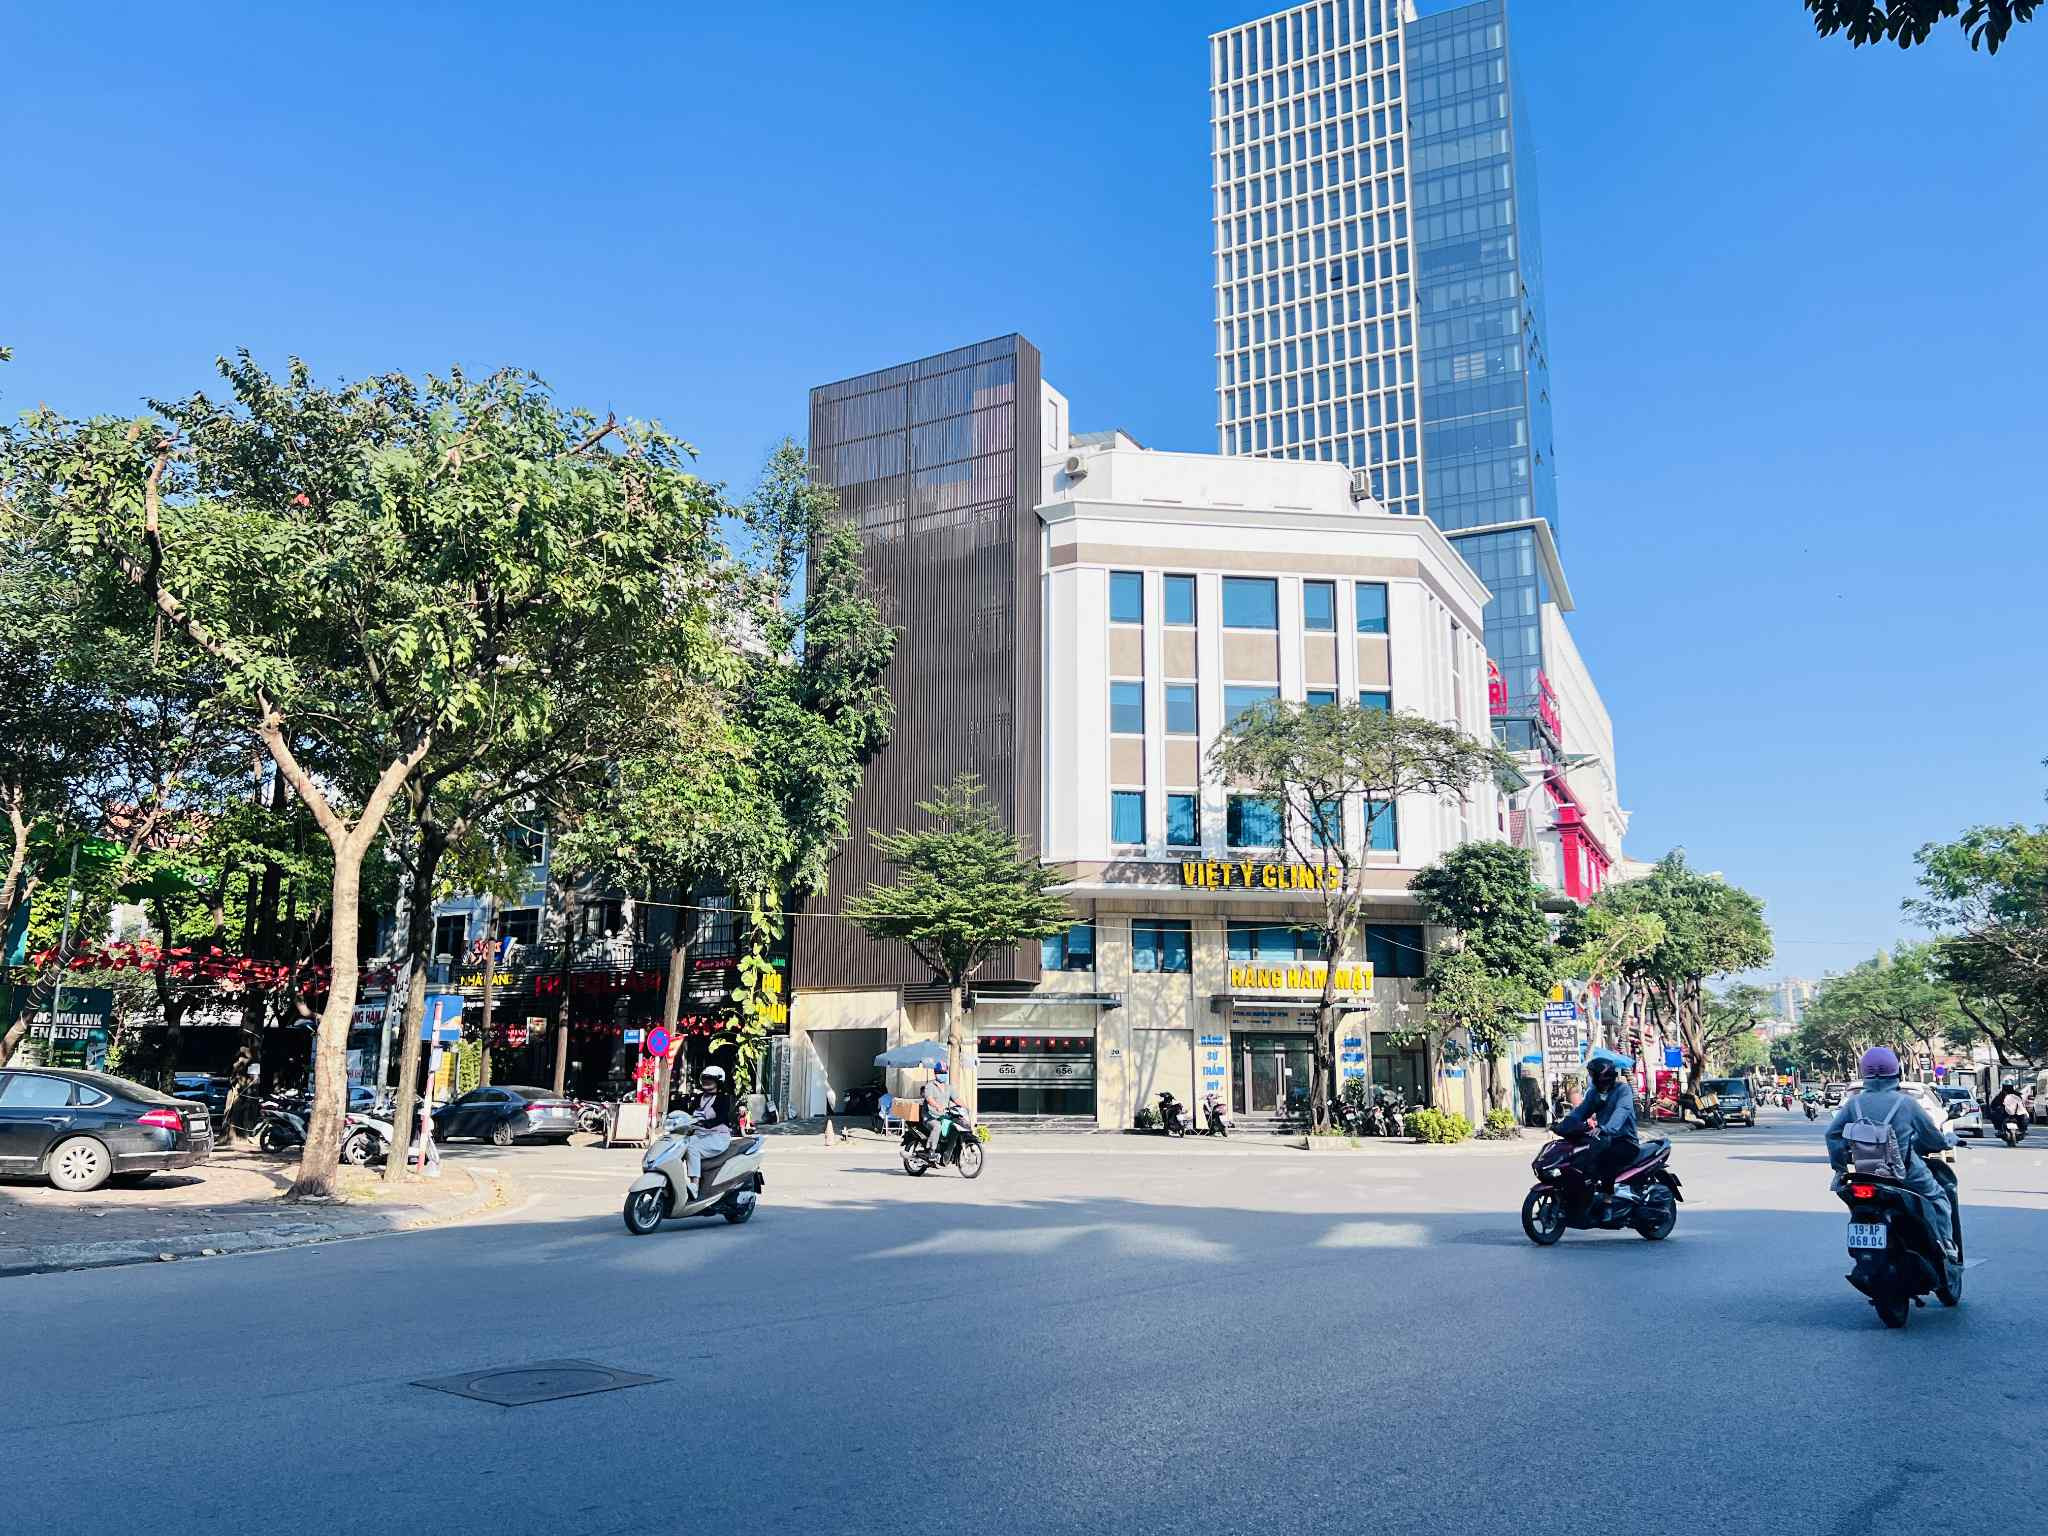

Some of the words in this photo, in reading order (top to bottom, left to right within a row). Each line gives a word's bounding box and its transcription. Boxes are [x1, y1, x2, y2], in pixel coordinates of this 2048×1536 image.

[1183, 858, 1232, 892] VIỆT
[1240, 858, 1254, 888] Ý
[1262, 863, 1339, 890] CLINIC
[1286, 964, 1328, 991] HÀM
[1333, 965, 1373, 995] MẶT
[1549, 1025, 1575, 1037] King's
[1551, 1037, 1575, 1047] Hotel
[999, 1067, 1016, 1075] 656
[1056, 1067, 1073, 1075] 656
[1854, 1224, 1880, 1236] 19-AP
